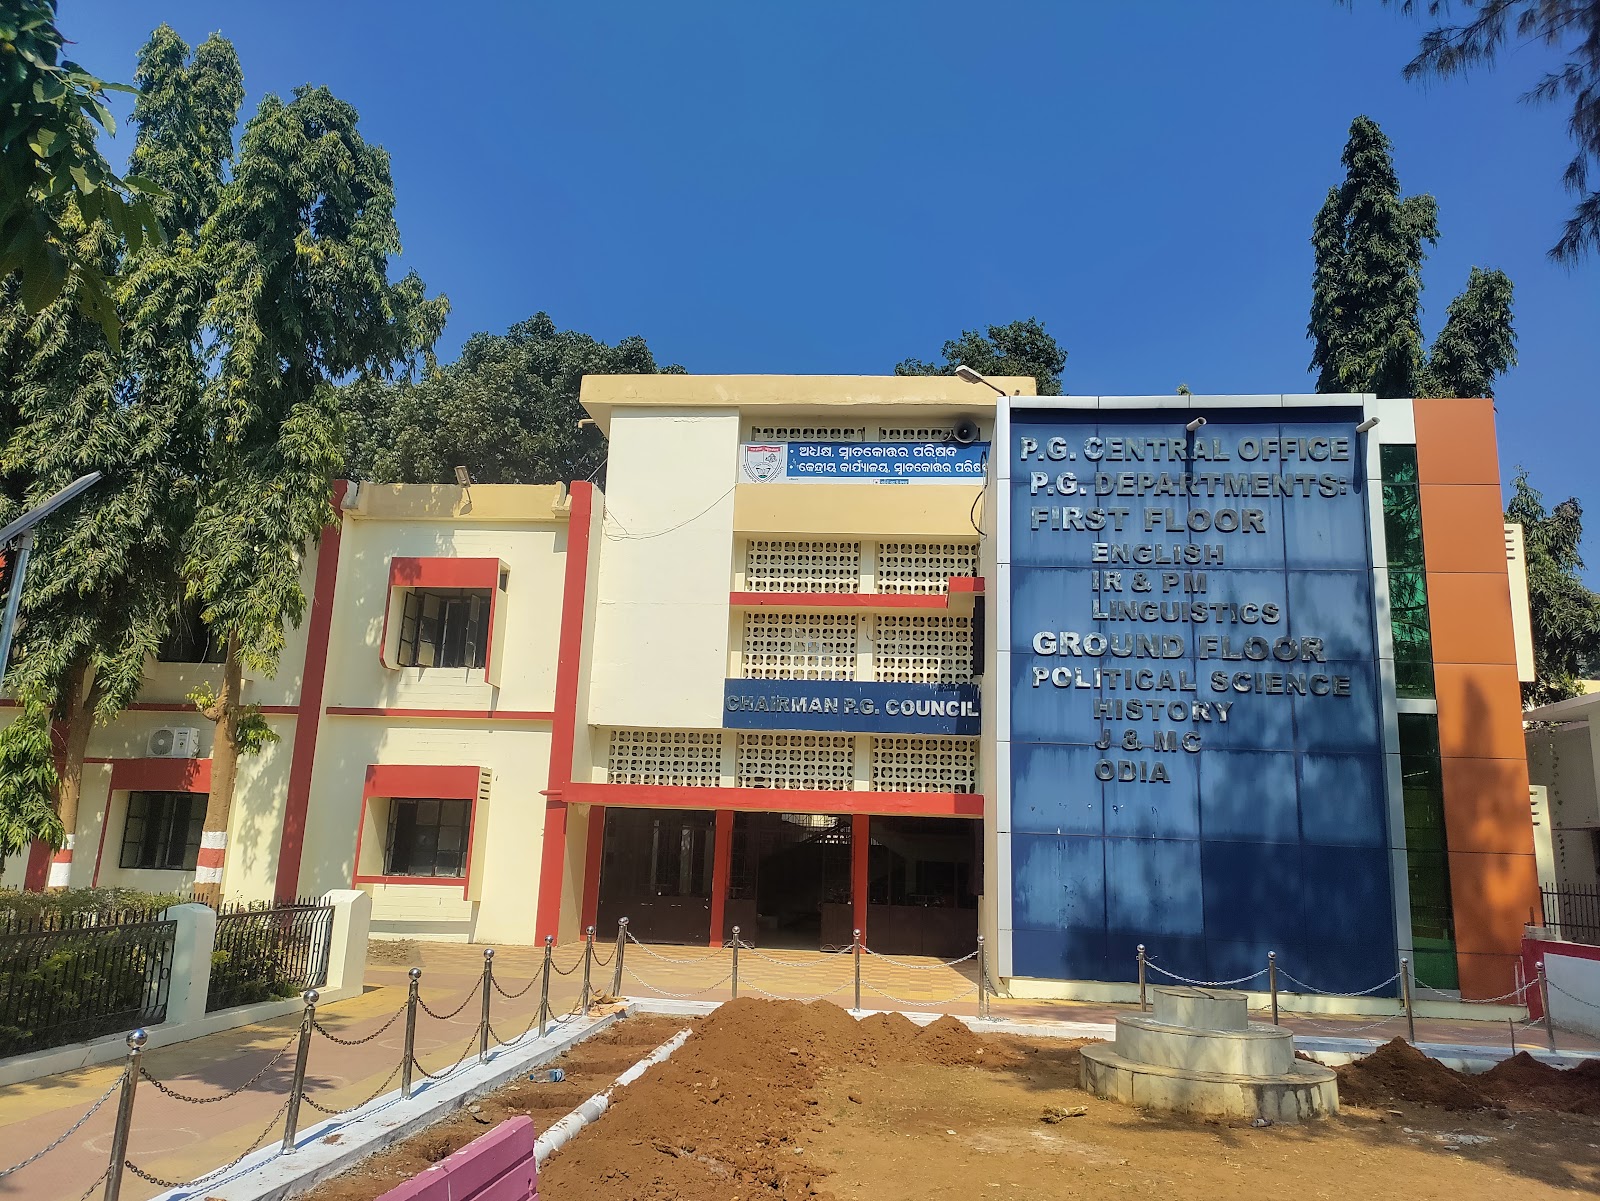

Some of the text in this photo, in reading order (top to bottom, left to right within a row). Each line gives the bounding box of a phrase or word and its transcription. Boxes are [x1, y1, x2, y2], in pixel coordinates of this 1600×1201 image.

[913, 444, 957, 457] ପରିଷଦ
[1020, 437, 1349, 462] P.G. CENTRAL OFFICE
[1030, 472, 1347, 498] P.G. DEPARTMENTS:
[1031, 506, 1266, 533] FIRST FLOOR
[1092, 542, 1224, 565] ENGLISH
[1092, 570, 1207, 594] IR & PM
[1092, 600, 1281, 624] LINGUISTICS
[1033, 631, 1327, 663] GROUND FLOOR
[1032, 667, 1351, 696] POLITICAL SCIENCE
[726, 694, 979, 717] CHAIRMAN P.G. COUNCIL
[1094, 698, 1234, 723] HISTORY
[1094, 728, 1202, 753] J & MC
[1095, 760, 1171, 783] ODIA
